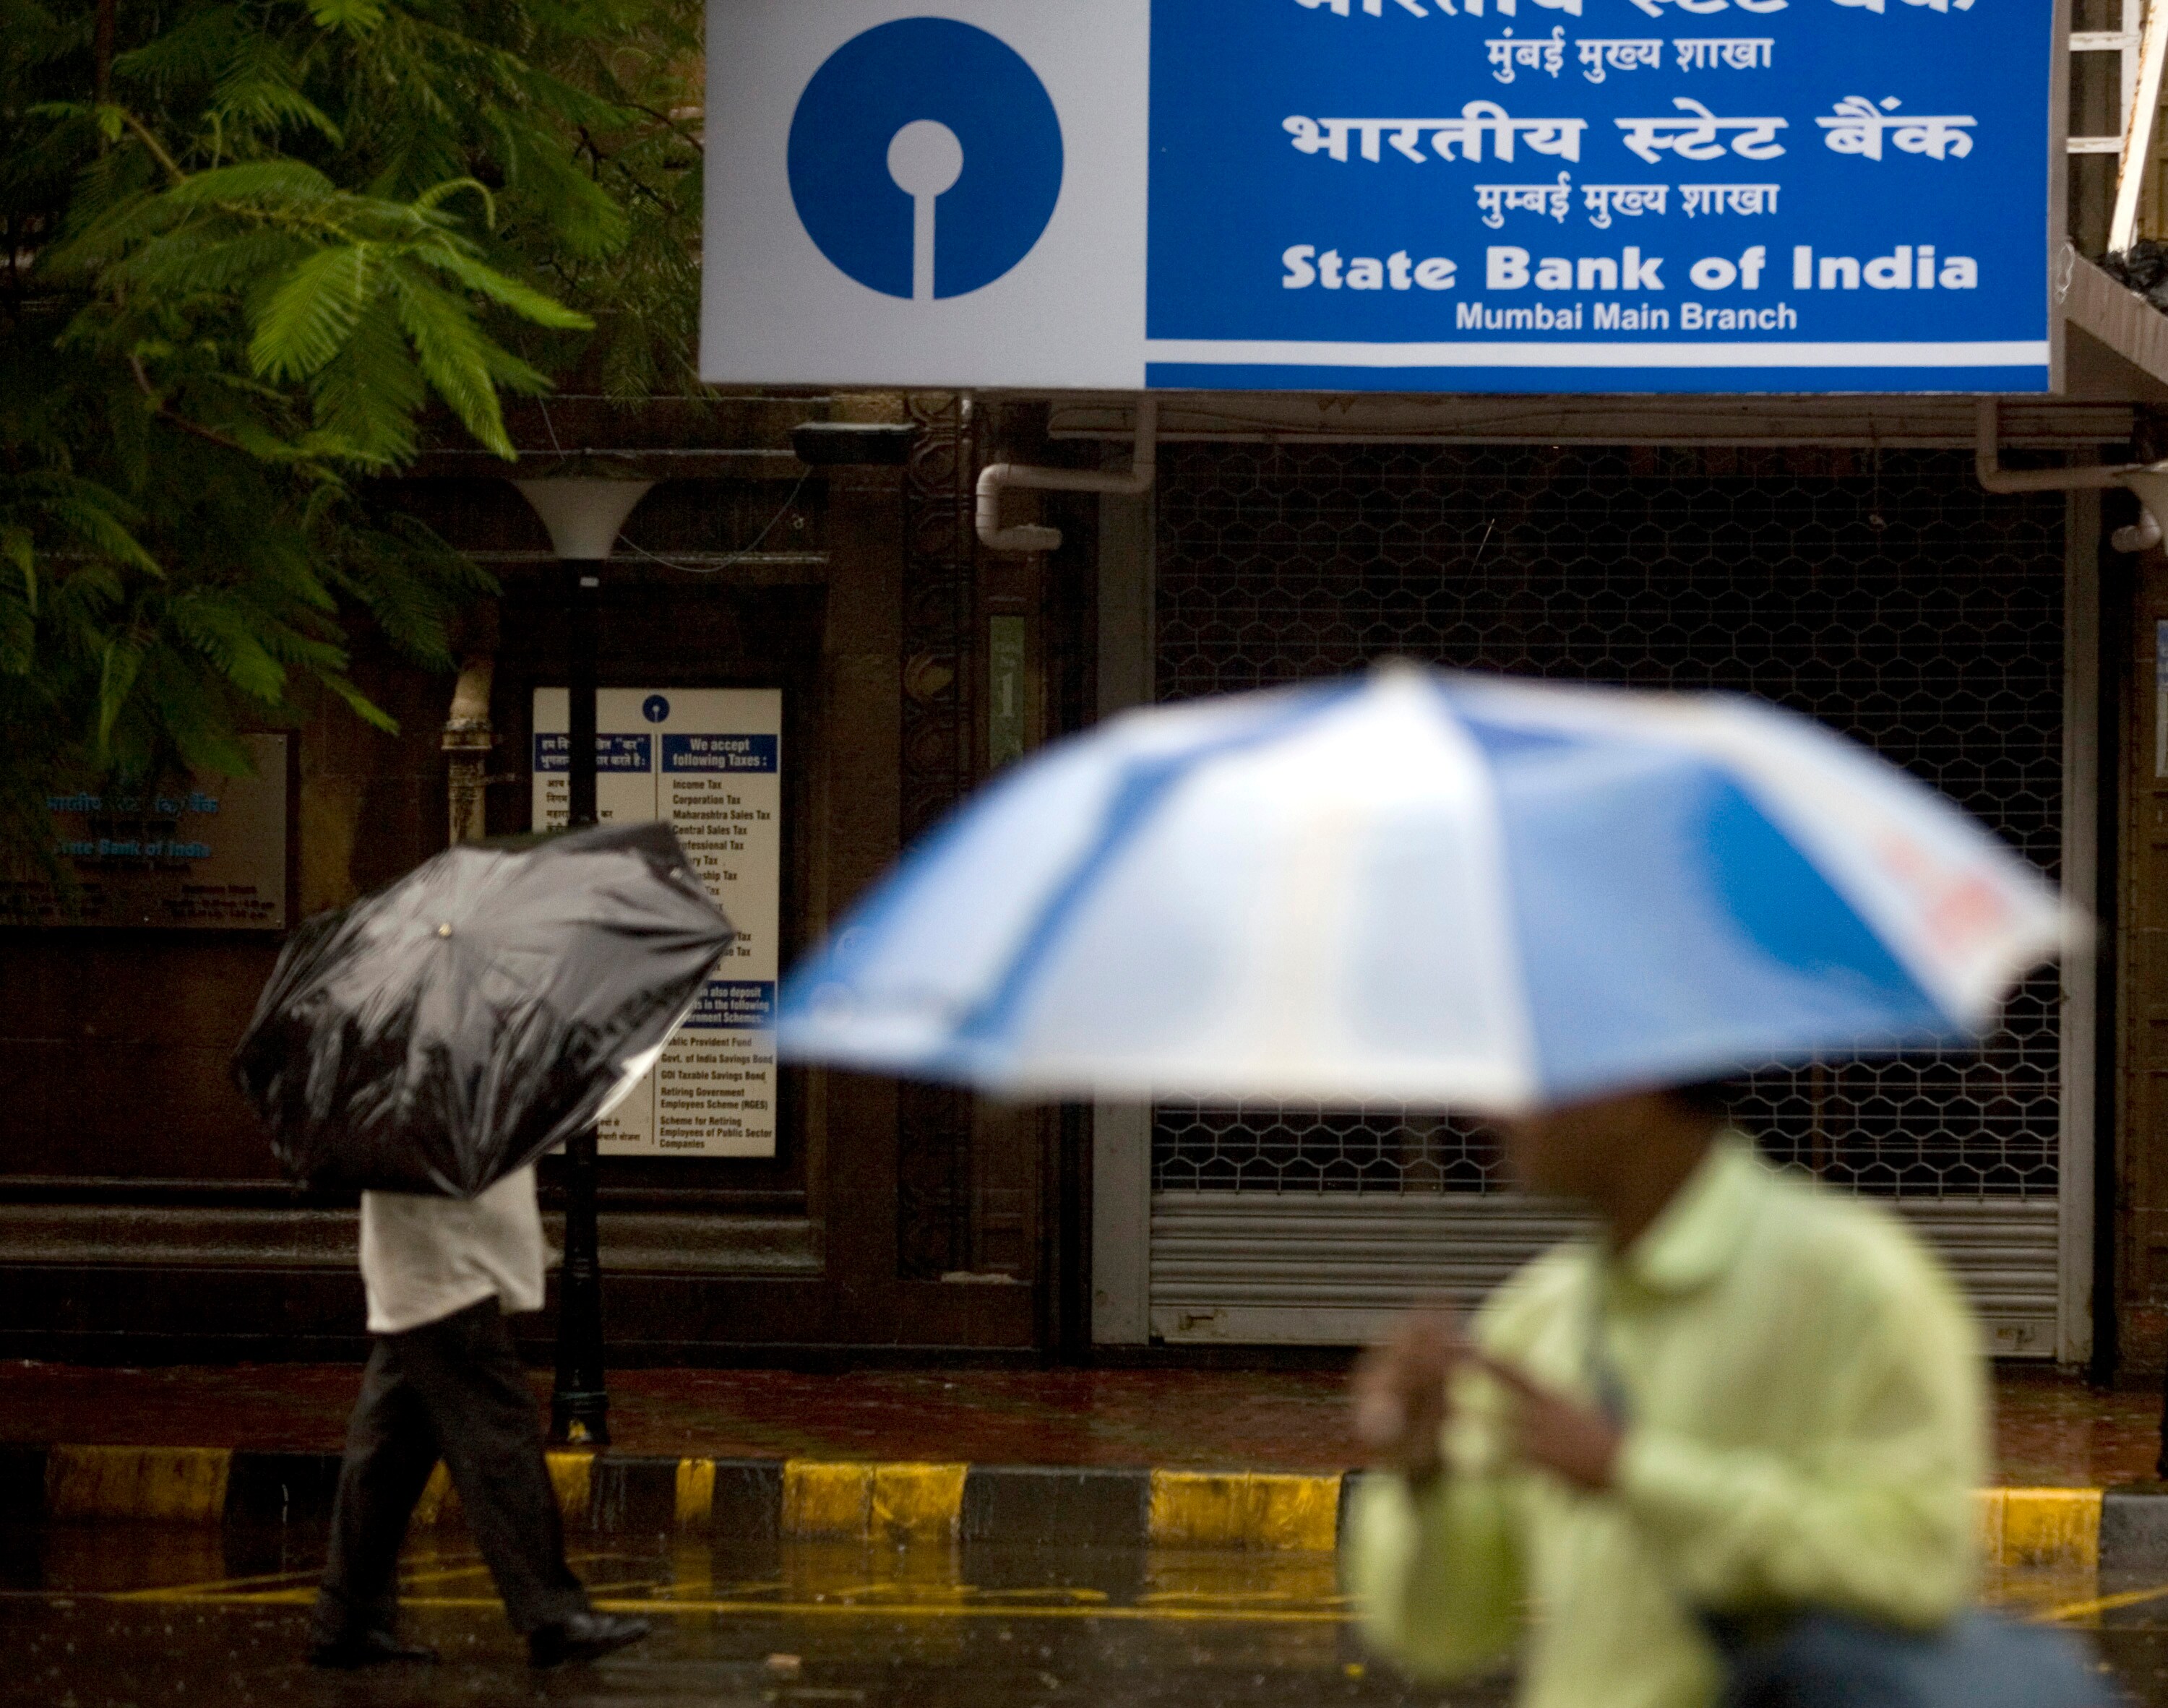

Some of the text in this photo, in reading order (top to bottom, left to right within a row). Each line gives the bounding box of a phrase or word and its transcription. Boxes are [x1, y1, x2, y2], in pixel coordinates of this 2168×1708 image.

[1486, 26, 1774, 84] मुंबई मुख्य शाखा
[1282, 95, 1977, 164] भारतीय स्टेट बैंक
[1474, 171, 1780, 229] मुम्बई मुख्य शाखा
[1282, 244, 1978, 290] State Bank of India
[1456, 302, 1797, 330] Mumbai Main Branch
[690, 738, 750, 753] We accept
[673, 754, 726, 768] following
[673, 780, 721, 789] Income Tax
[673, 795, 741, 807] Corporation Tax
[673, 810, 771, 821] Maharashtra Sales Tax
[673, 825, 747, 835] Central Sales Tax
[680, 840, 744, 850] ofessional Tax
[703, 855, 718, 866] Tax
[723, 871, 737, 881] Tax
[737, 932, 752, 941] Tax
[737, 946, 751, 957] Tax
[730, 987, 761, 1000] deposit
[714, 999, 728, 1009] the
[730, 999, 769, 1012] following
[690, 1037, 730, 1046] Provident
[731, 1037, 752, 1046] Fund
[661, 1053, 773, 1066] Govt. of India Savings Bond
[661, 1071, 766, 1082] GOI Taxable Savings Bond
[661, 1087, 745, 1097] Retiring Government
[661, 1100, 768, 1111] Employees Scheme (RGES)
[660, 1116, 742, 1127] Scheme for Retiring
[660, 1128, 773, 1138] Employees of Public Sector
[659, 1139, 705, 1150] Companies
